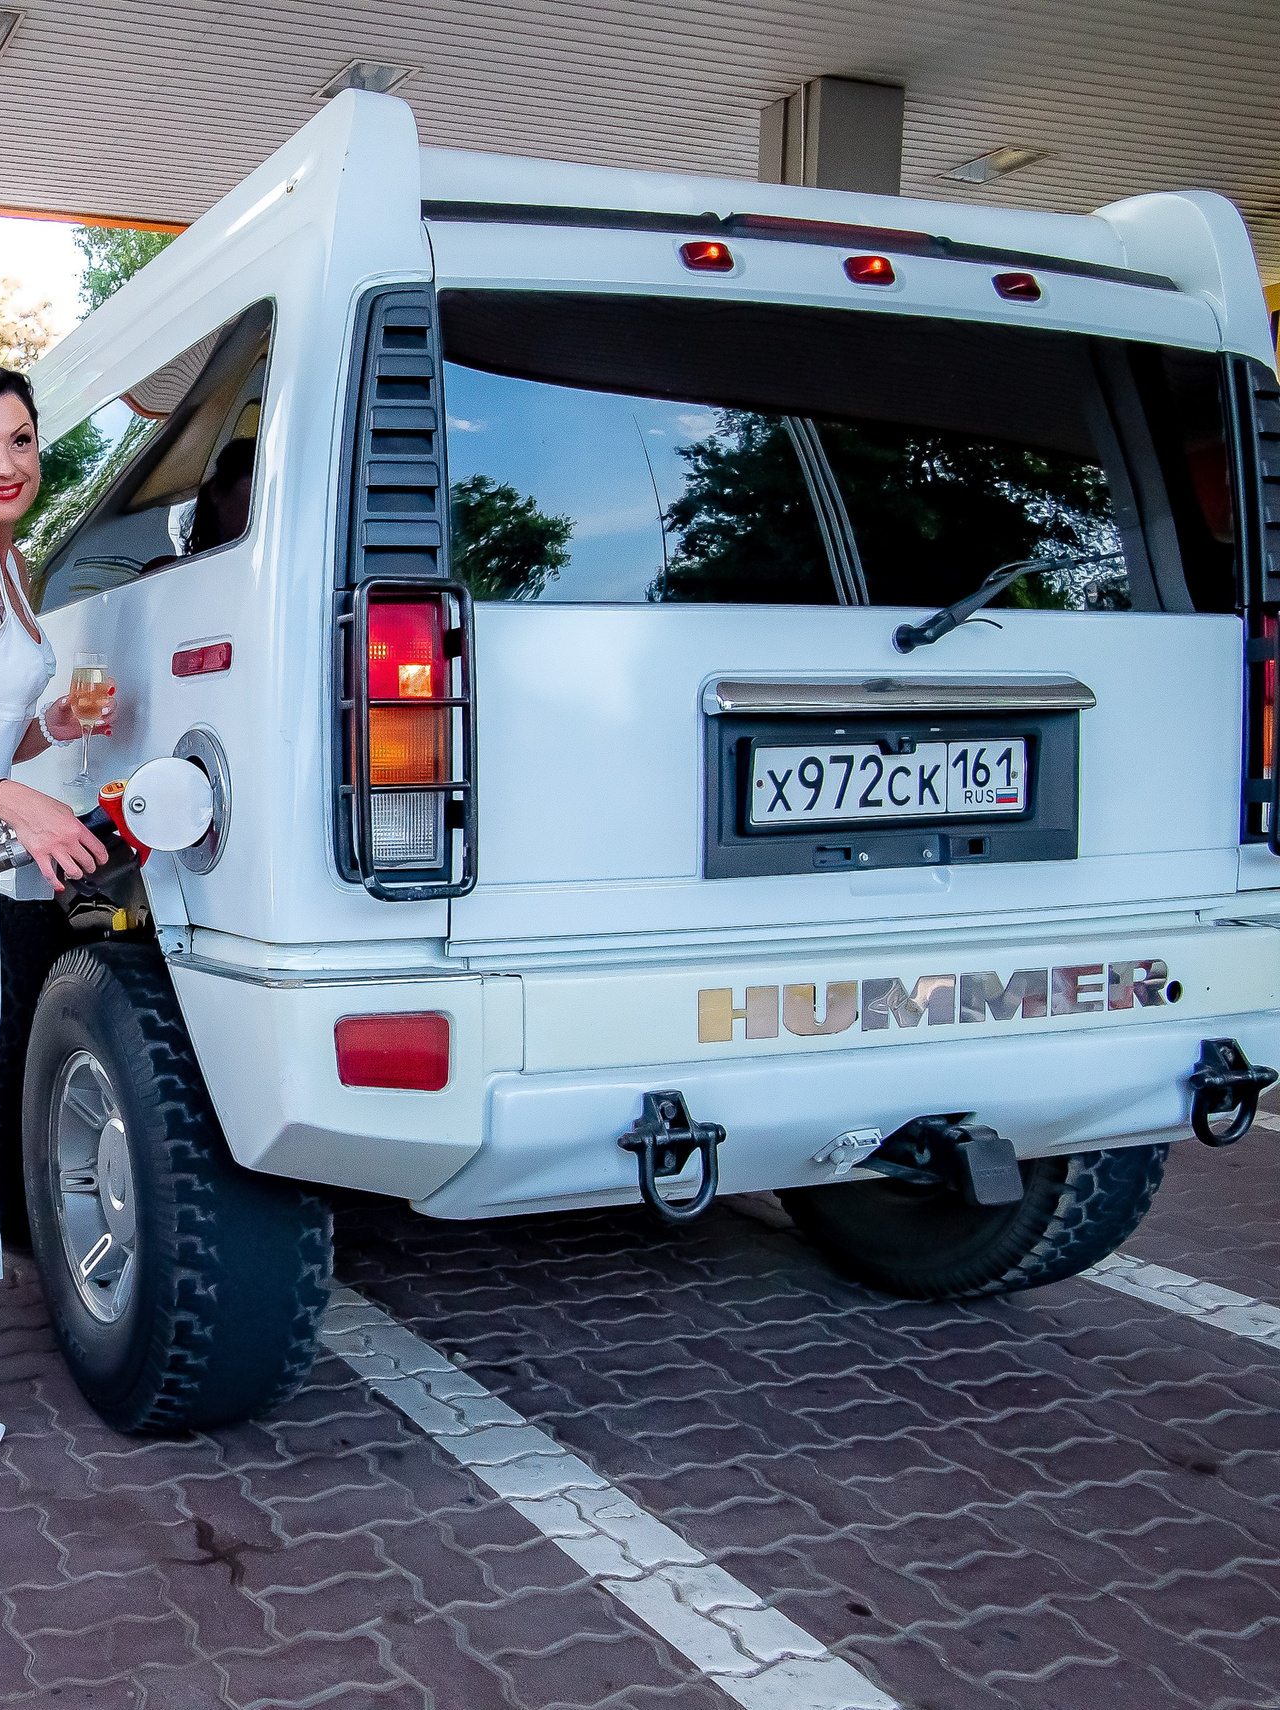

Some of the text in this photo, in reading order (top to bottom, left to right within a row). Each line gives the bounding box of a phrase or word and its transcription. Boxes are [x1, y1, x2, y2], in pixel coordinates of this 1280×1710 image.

[951, 746, 1014, 790] 161
[963, 788, 995, 805] RUS
[697, 958, 1171, 1044] HUMMER
